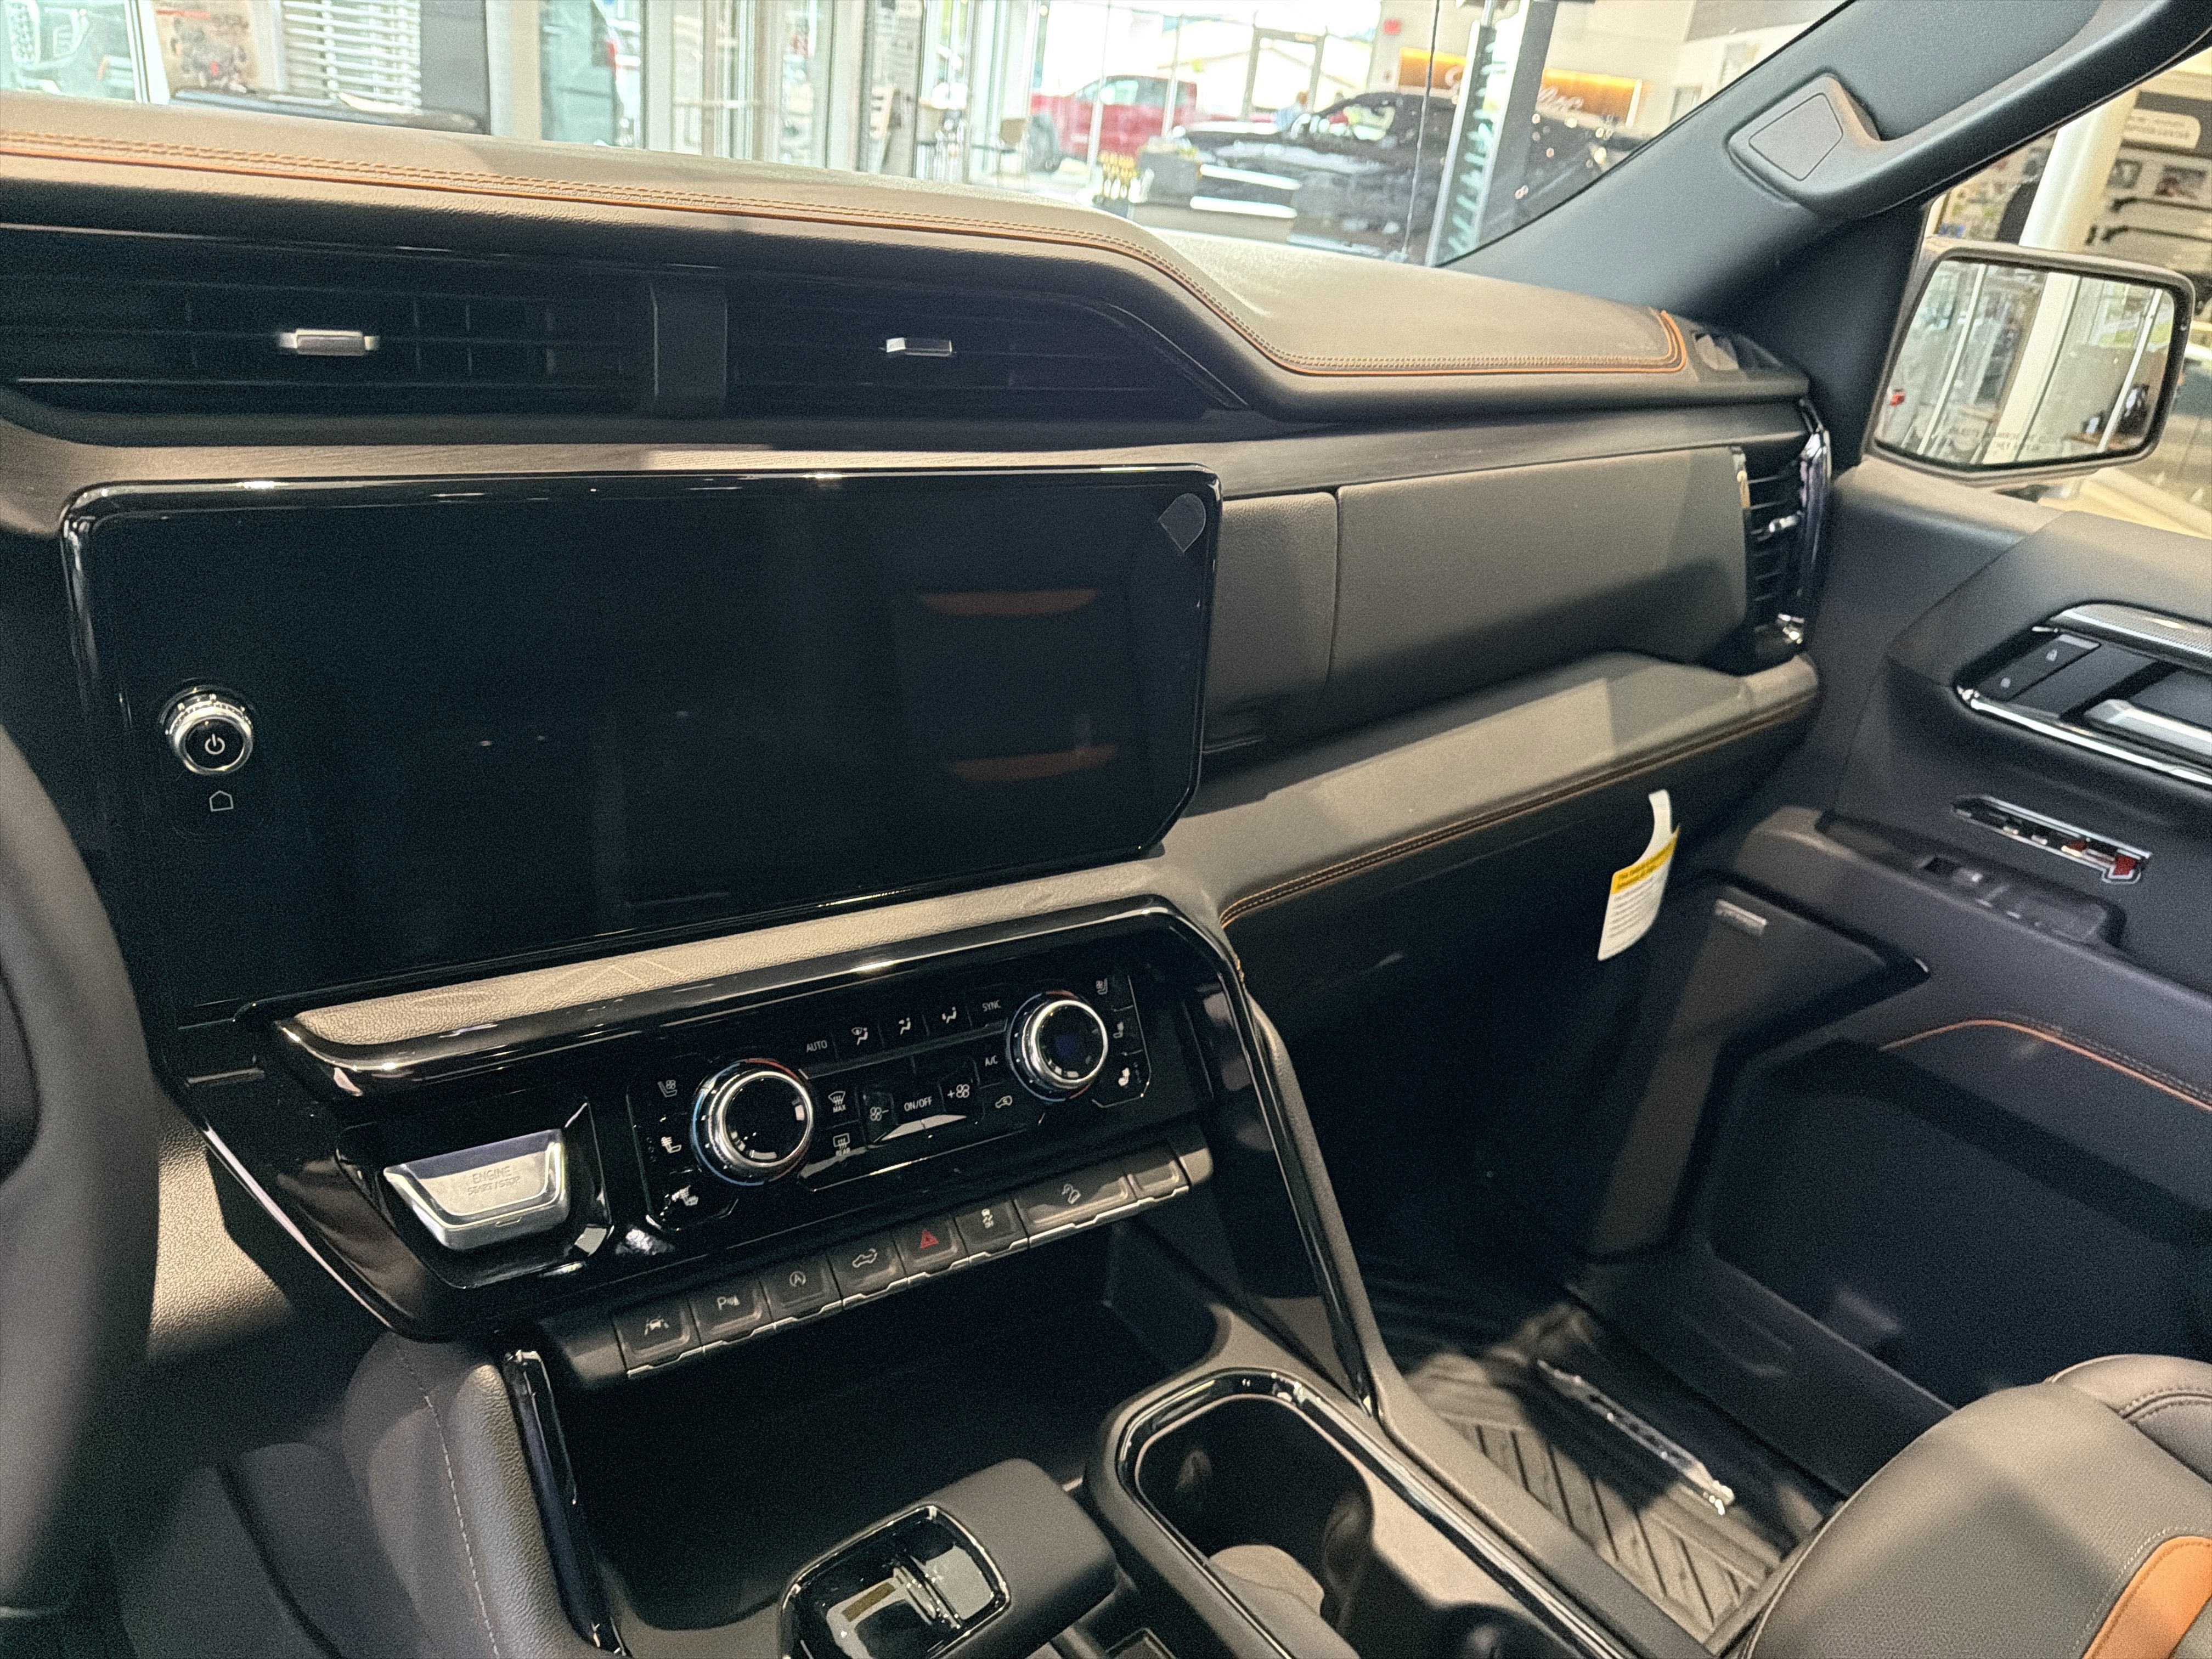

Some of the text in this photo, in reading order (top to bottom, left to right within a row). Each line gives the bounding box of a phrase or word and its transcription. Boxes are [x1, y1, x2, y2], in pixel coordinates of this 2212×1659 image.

[982, 1000, 1002, 1012] SYNC
[806, 1039, 828, 1053] AUTO
[985, 1055, 998, 1067] A/C
[833, 1104, 847, 1114] MAX
[904, 1096, 932, 1112] ON/OFF
[472, 1165, 512, 1184] ENGINE
